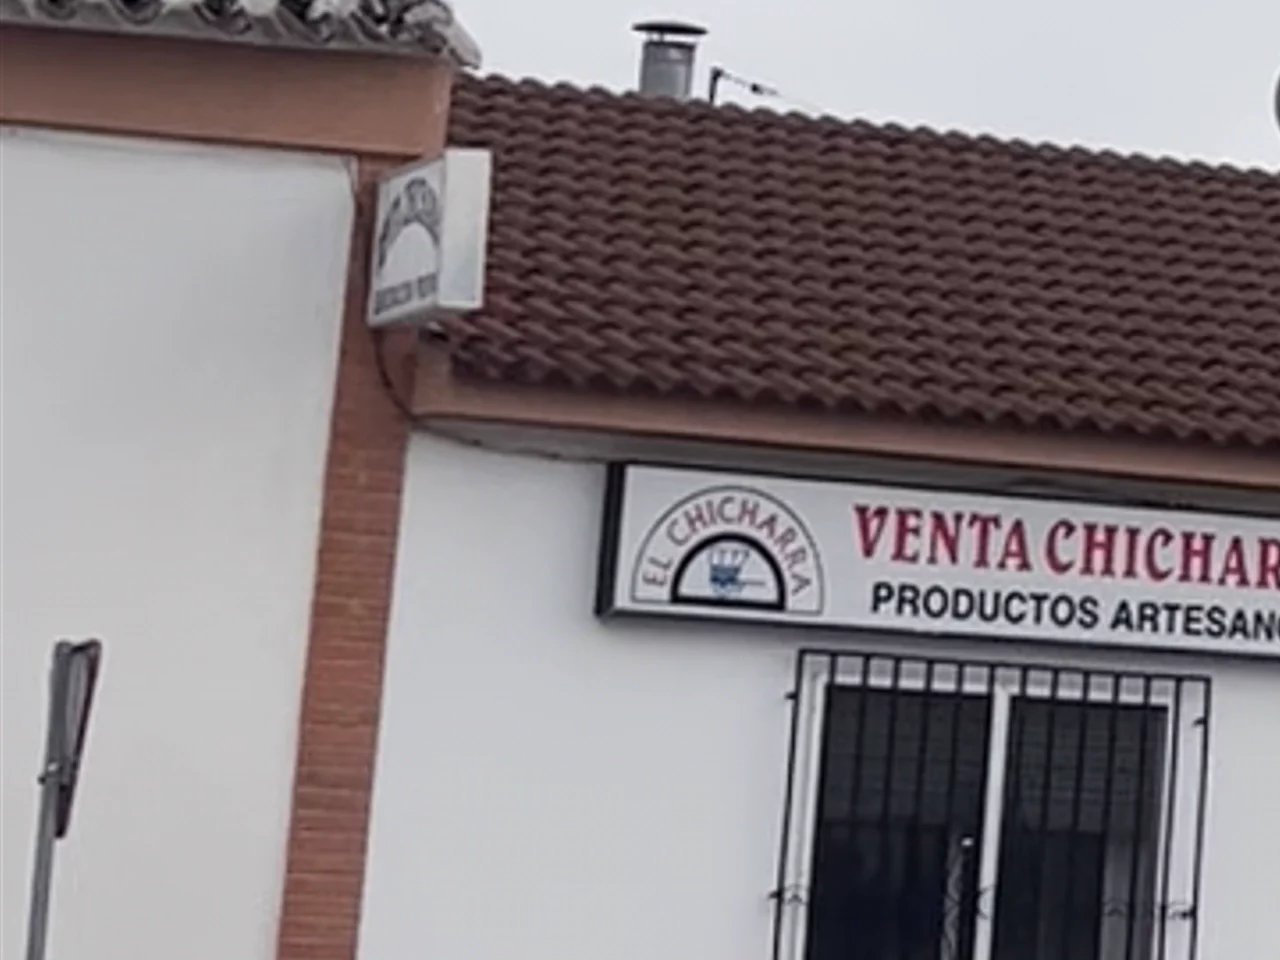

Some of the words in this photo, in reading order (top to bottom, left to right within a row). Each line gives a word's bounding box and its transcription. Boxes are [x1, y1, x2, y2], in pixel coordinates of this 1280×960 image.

[642, 556, 674, 588] EL
[666, 496, 812, 597] CHICHARRA
[852, 504, 1032, 572] VENTA
[871, 581, 1100, 629] PRODUCTOS
